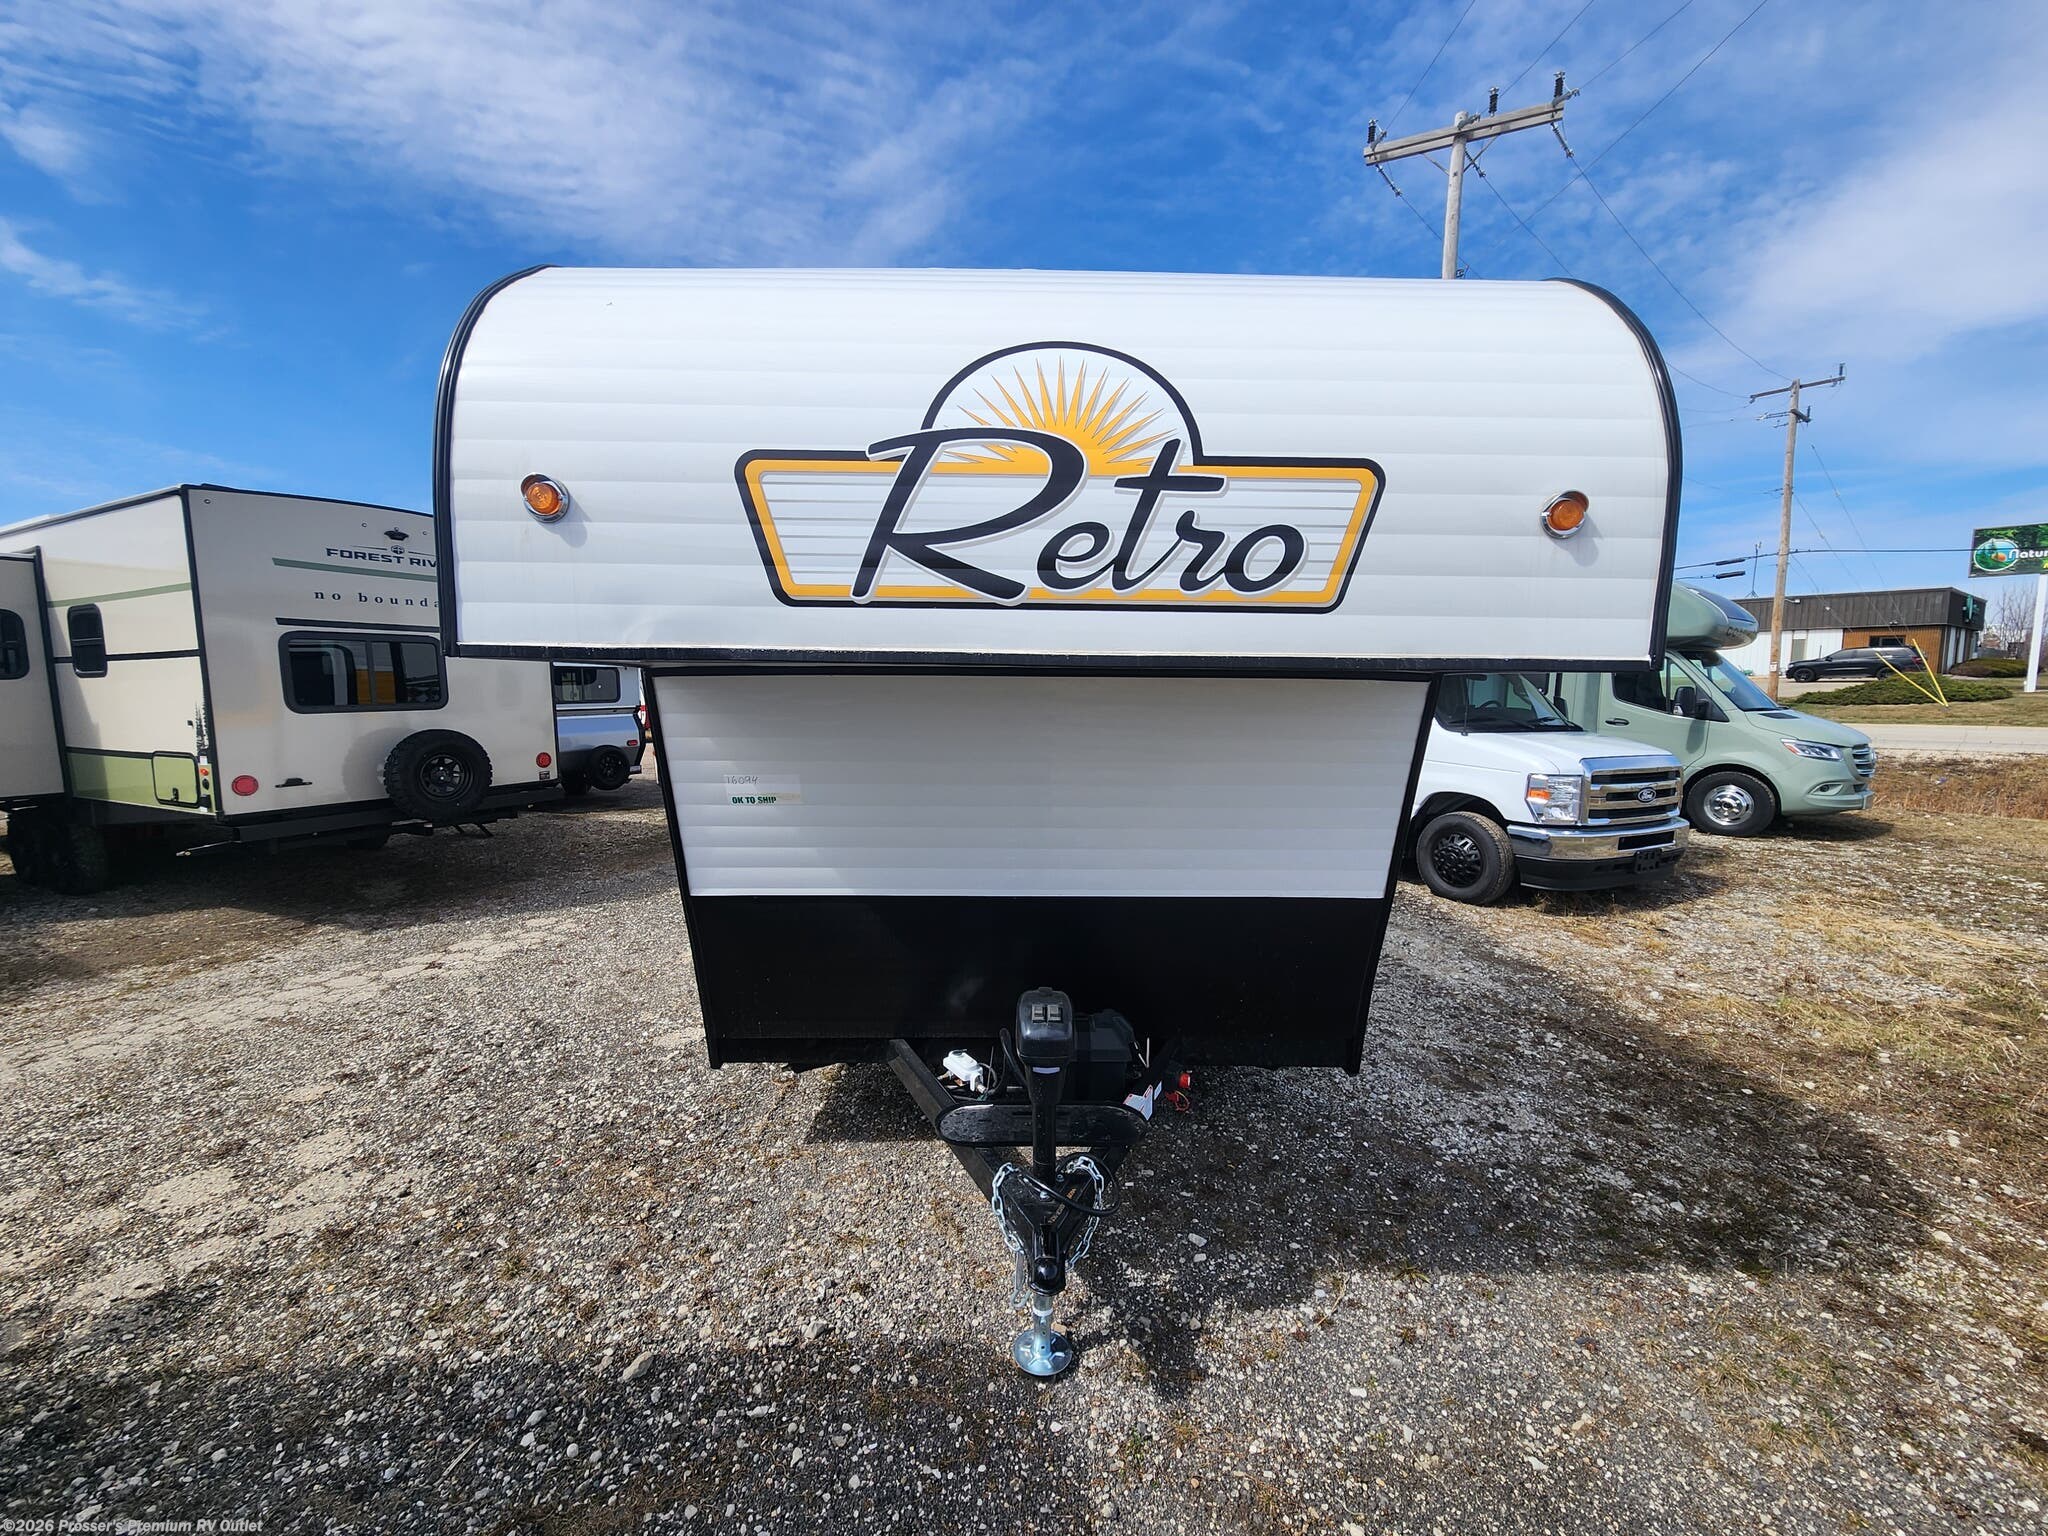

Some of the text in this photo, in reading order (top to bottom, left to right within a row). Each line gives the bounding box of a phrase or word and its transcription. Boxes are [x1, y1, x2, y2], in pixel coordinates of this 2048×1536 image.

[851, 427, 1306, 602] Retro
[325, 547, 405, 564] FOREST
[314, 590, 342, 601] no
[732, 796, 777, 804] OK TO SHIP
